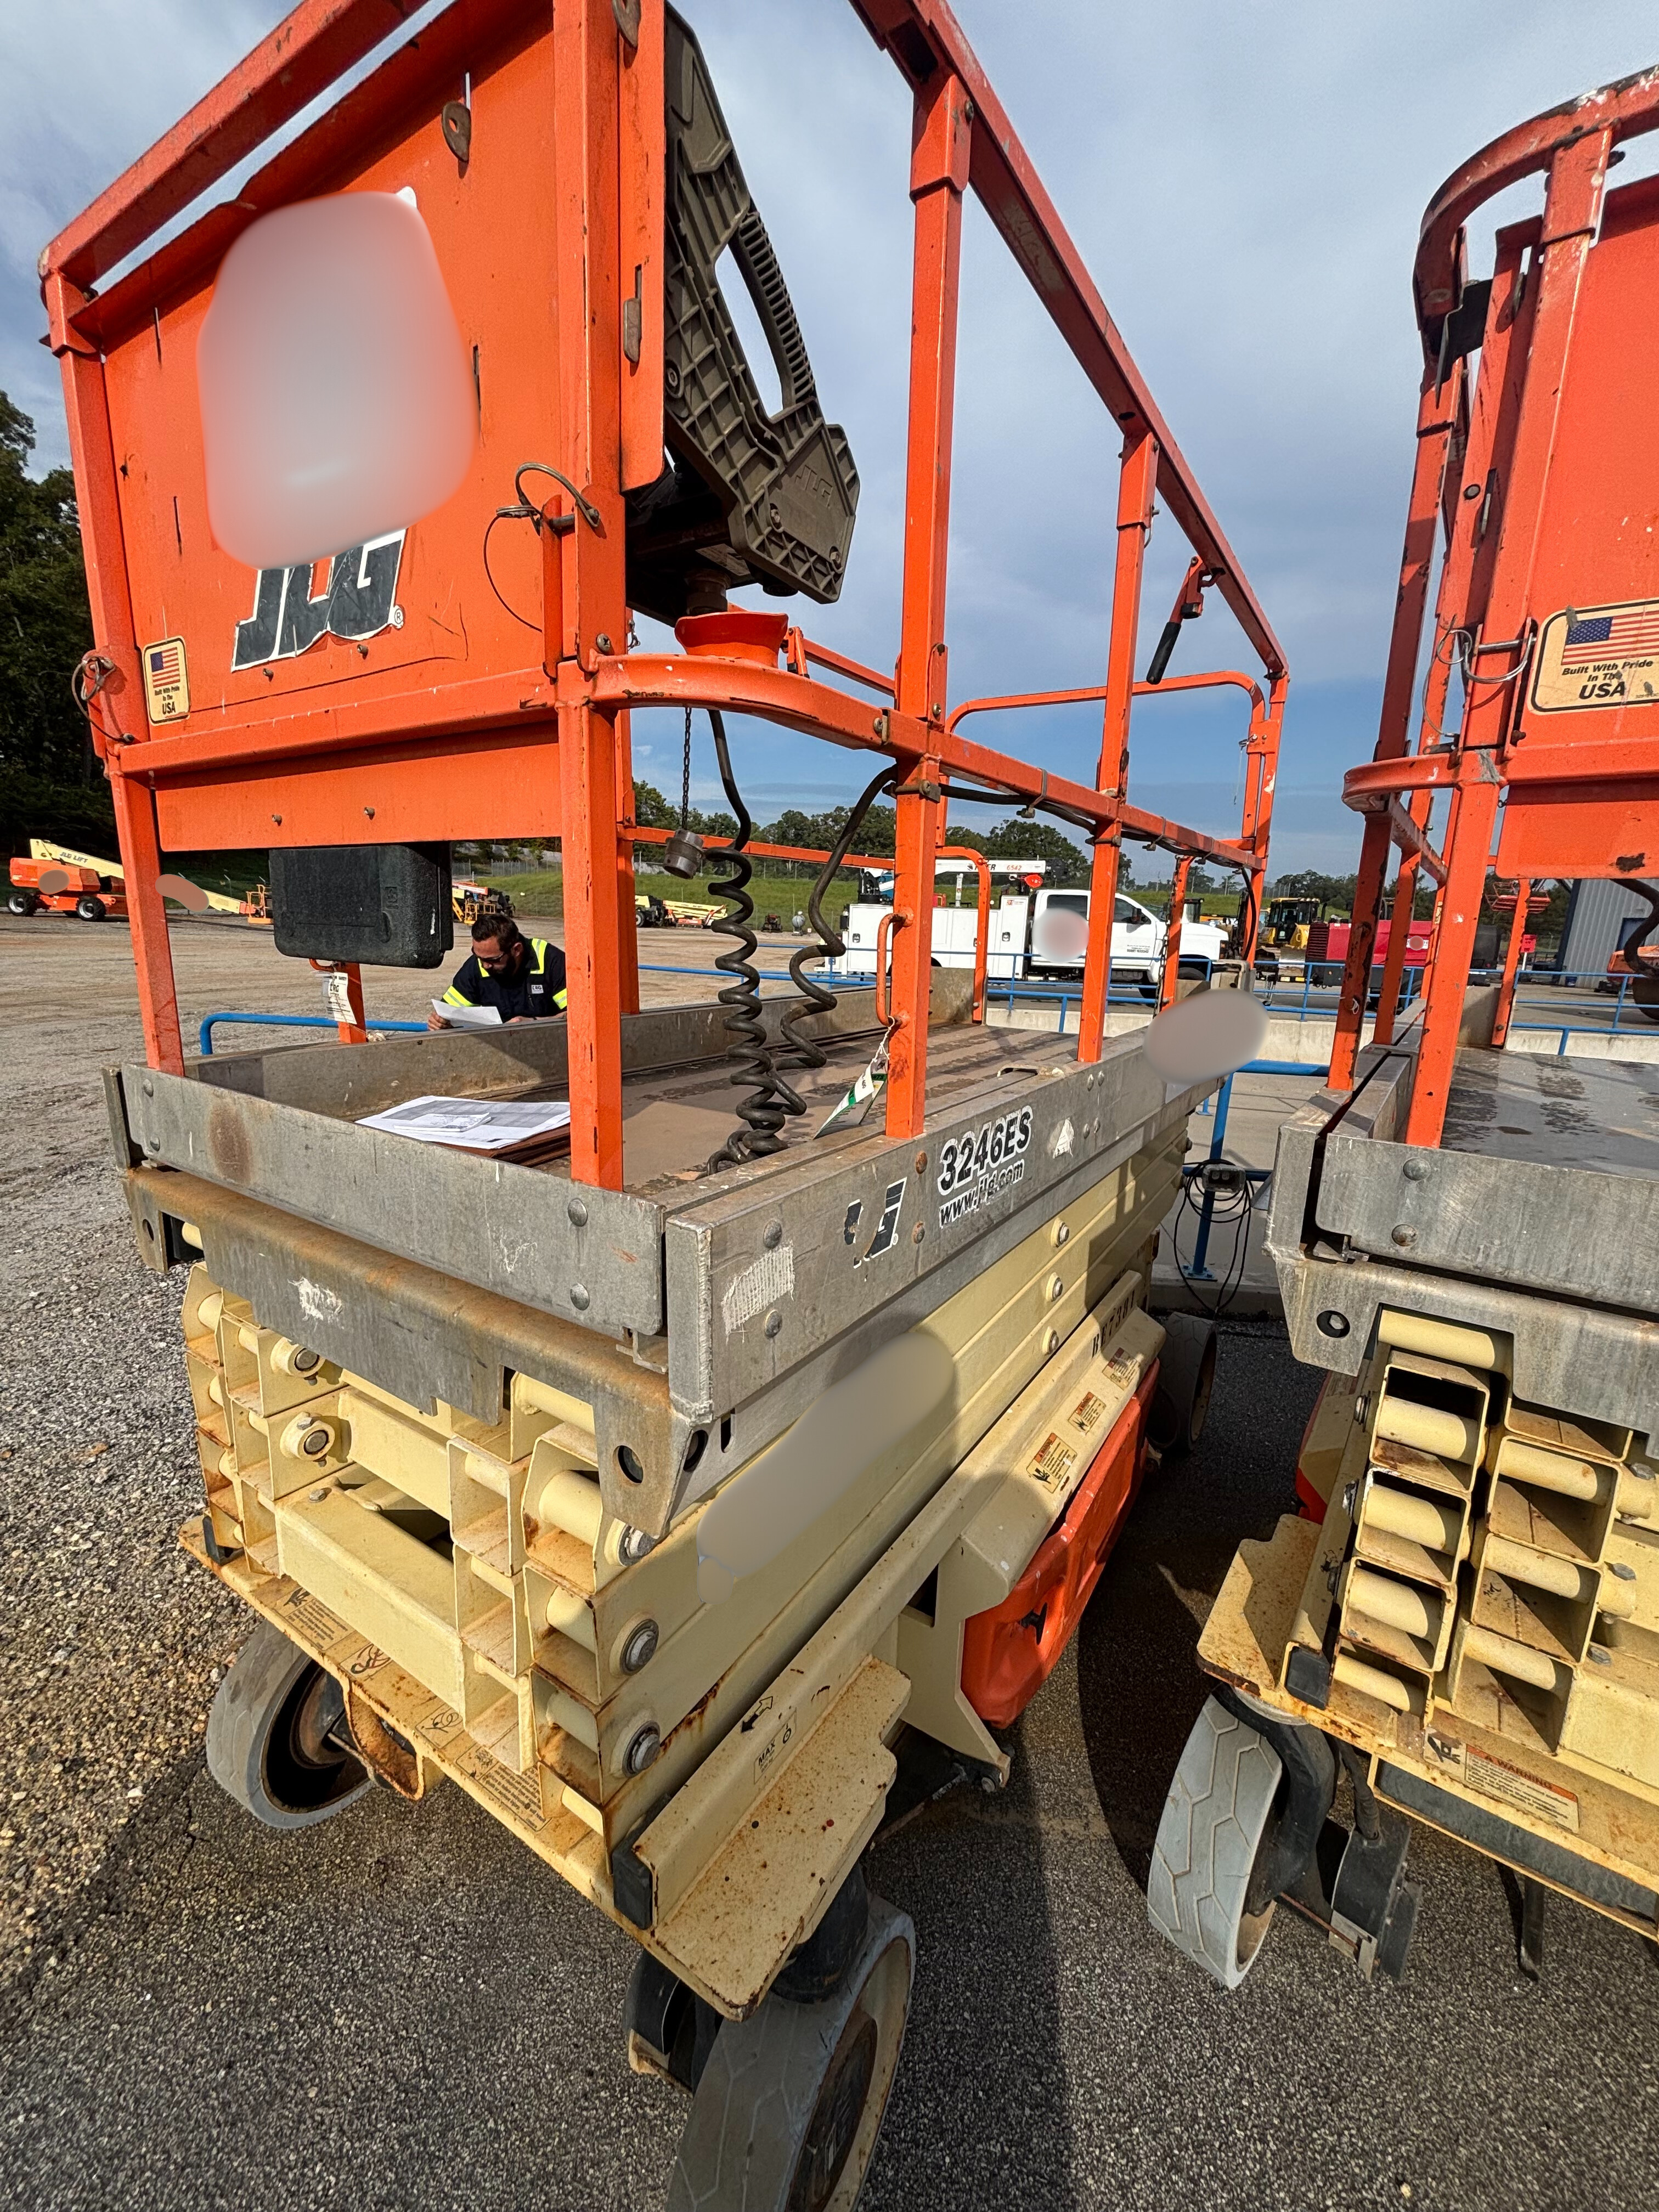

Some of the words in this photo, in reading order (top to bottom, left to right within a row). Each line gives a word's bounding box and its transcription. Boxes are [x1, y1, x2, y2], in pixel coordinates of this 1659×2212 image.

[1561, 665, 1589, 675] Built
[1593, 663, 1618, 673] With
[1621, 659, 1654, 669] Pride
[1587, 674, 1599, 682] In
[1602, 670, 1622, 681] Th
[1578, 681, 1625, 700] USA
[162, 701, 176, 715] USA
[939, 1107, 1032, 1194] 3246ES
[758, 1739, 775, 1766] MAX
[1497, 1759, 1552, 1790] WARNING
